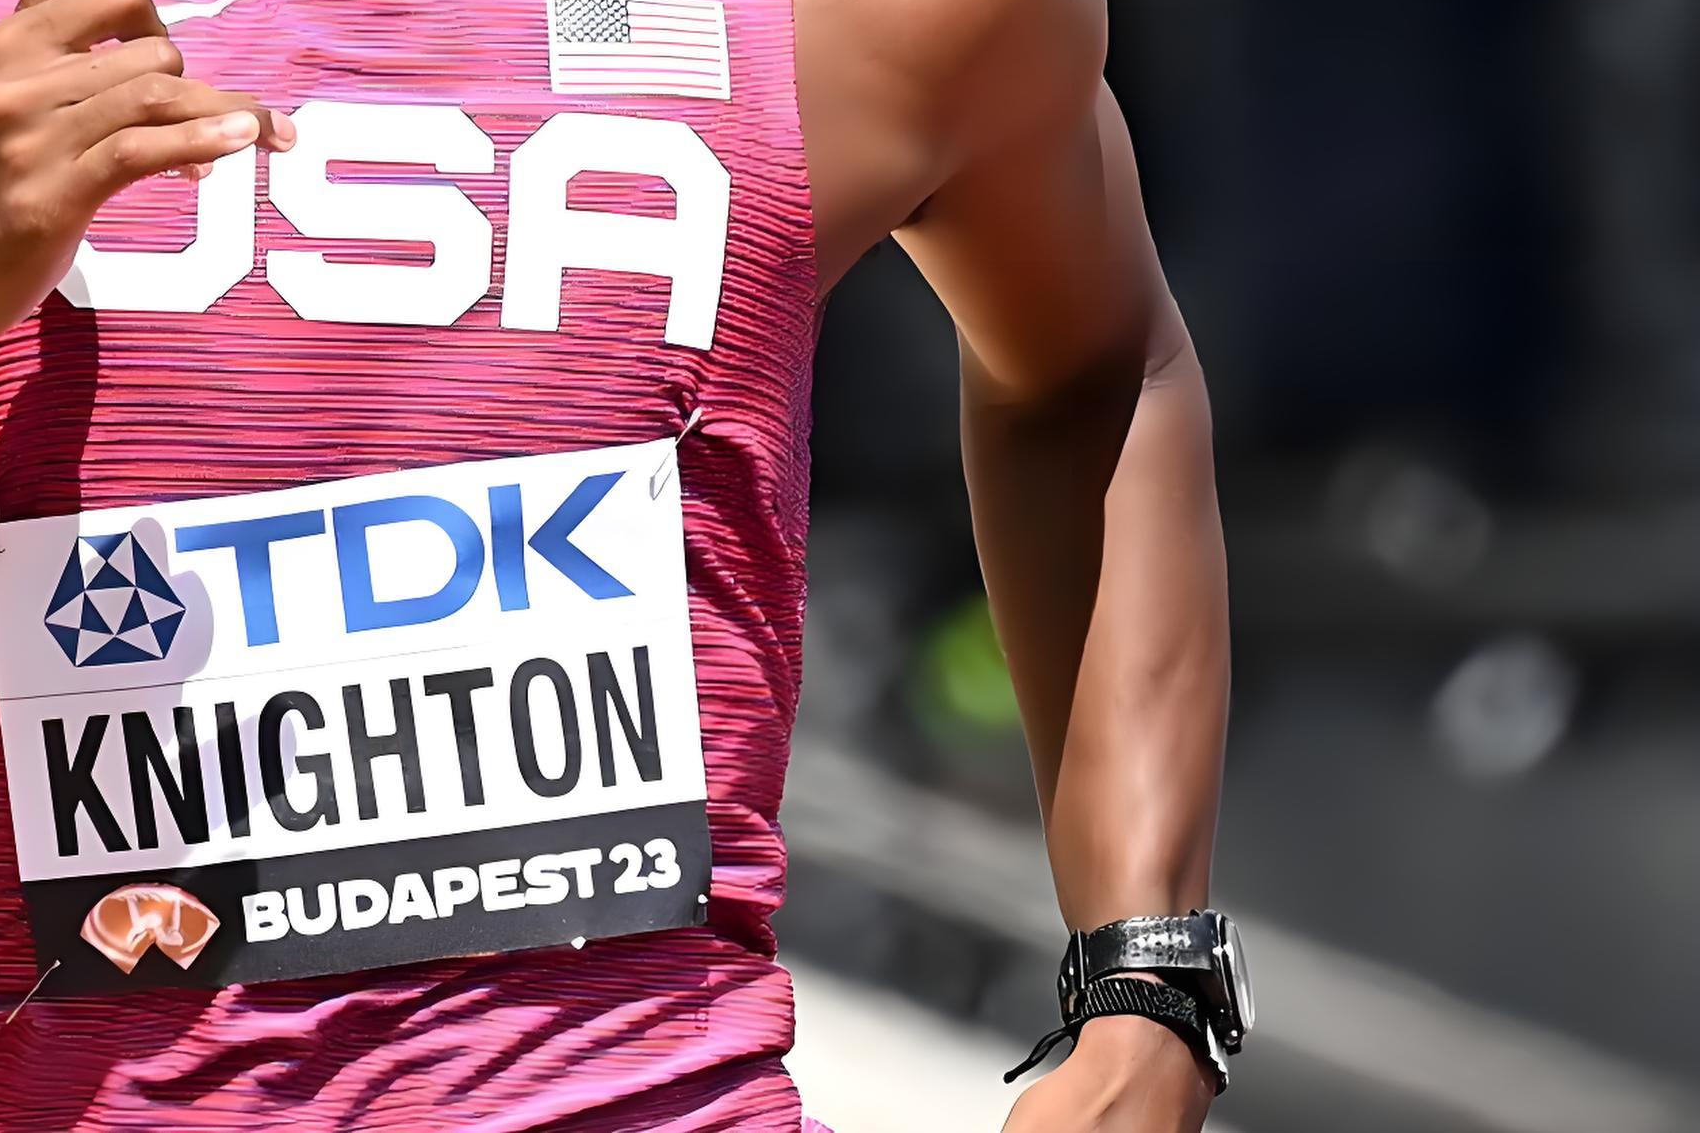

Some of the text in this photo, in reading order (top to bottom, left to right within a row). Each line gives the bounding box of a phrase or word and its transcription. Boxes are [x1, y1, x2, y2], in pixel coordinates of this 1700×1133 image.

[174, 471, 636, 648] TDK
[41, 646, 664, 857] KNIGHTON
[242, 839, 682, 942] BUDAPEST 23
